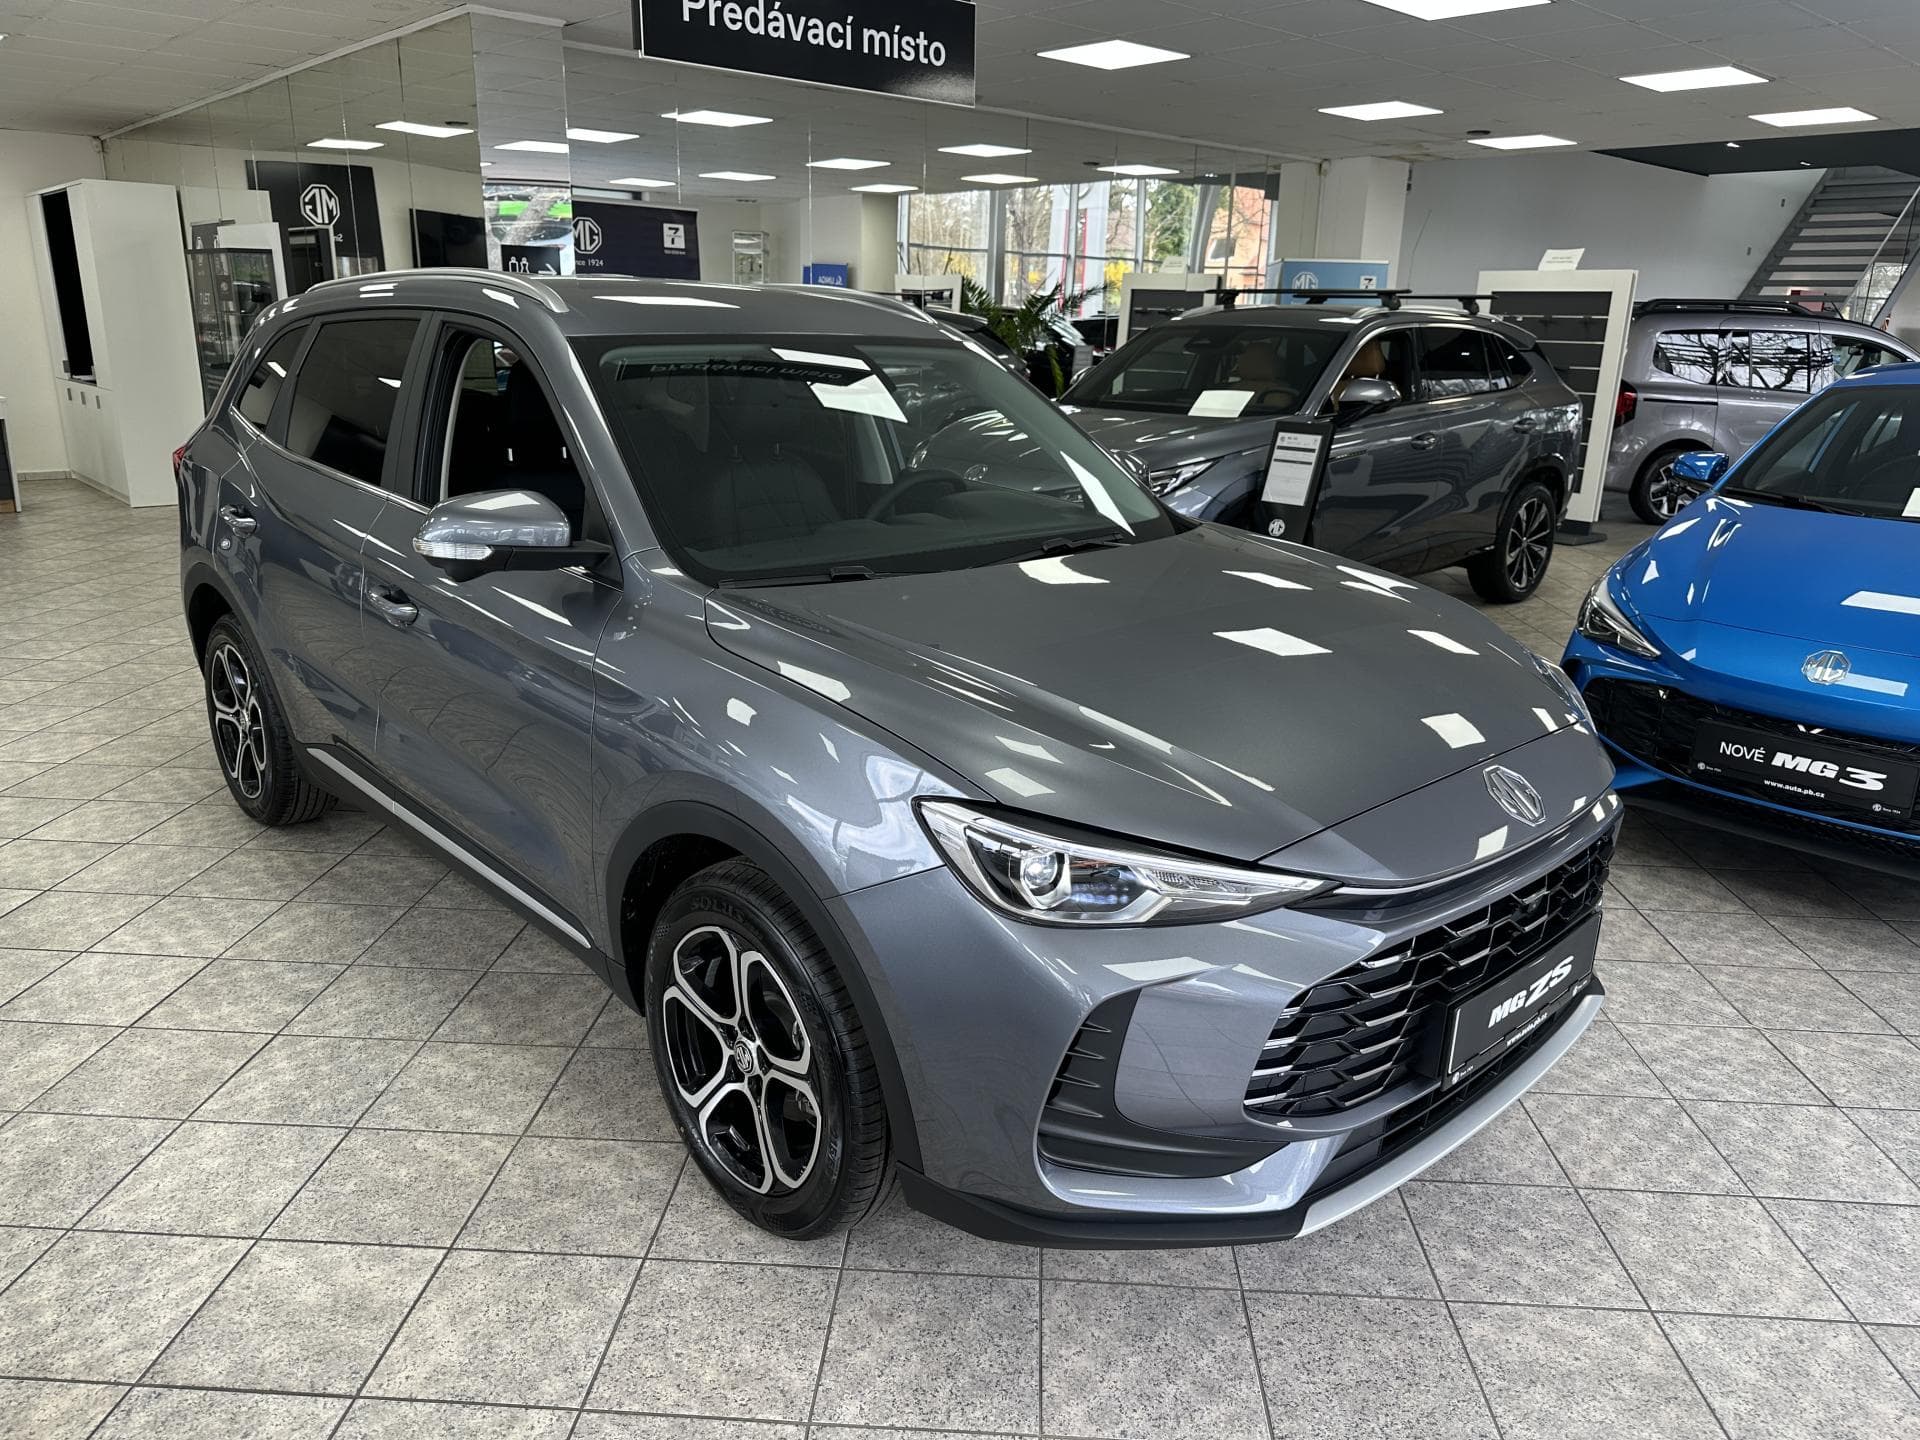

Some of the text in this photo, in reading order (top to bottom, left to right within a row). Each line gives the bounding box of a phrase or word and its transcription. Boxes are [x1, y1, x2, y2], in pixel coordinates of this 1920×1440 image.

[863, 25, 946, 67] místo
[588, 259, 604, 267] 1924
[1719, 741, 1766, 763] NOVÉ
